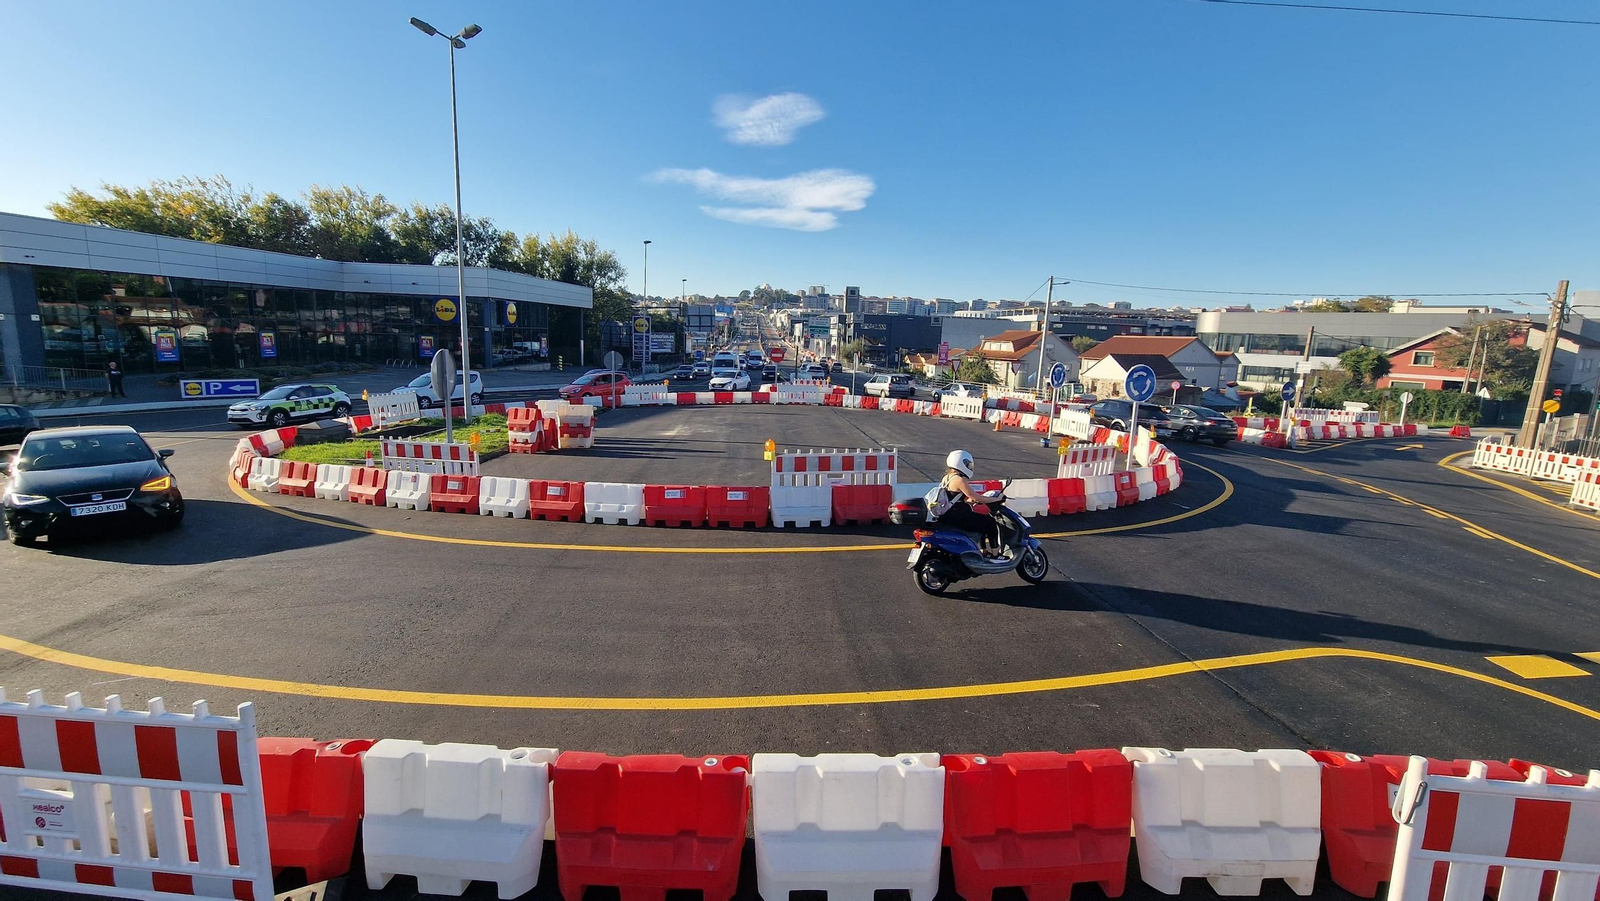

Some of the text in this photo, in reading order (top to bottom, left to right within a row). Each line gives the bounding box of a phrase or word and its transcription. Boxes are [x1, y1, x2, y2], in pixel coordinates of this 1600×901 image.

[209, 382, 222, 394] P
[78, 503, 125, 515] 7320 KDH
